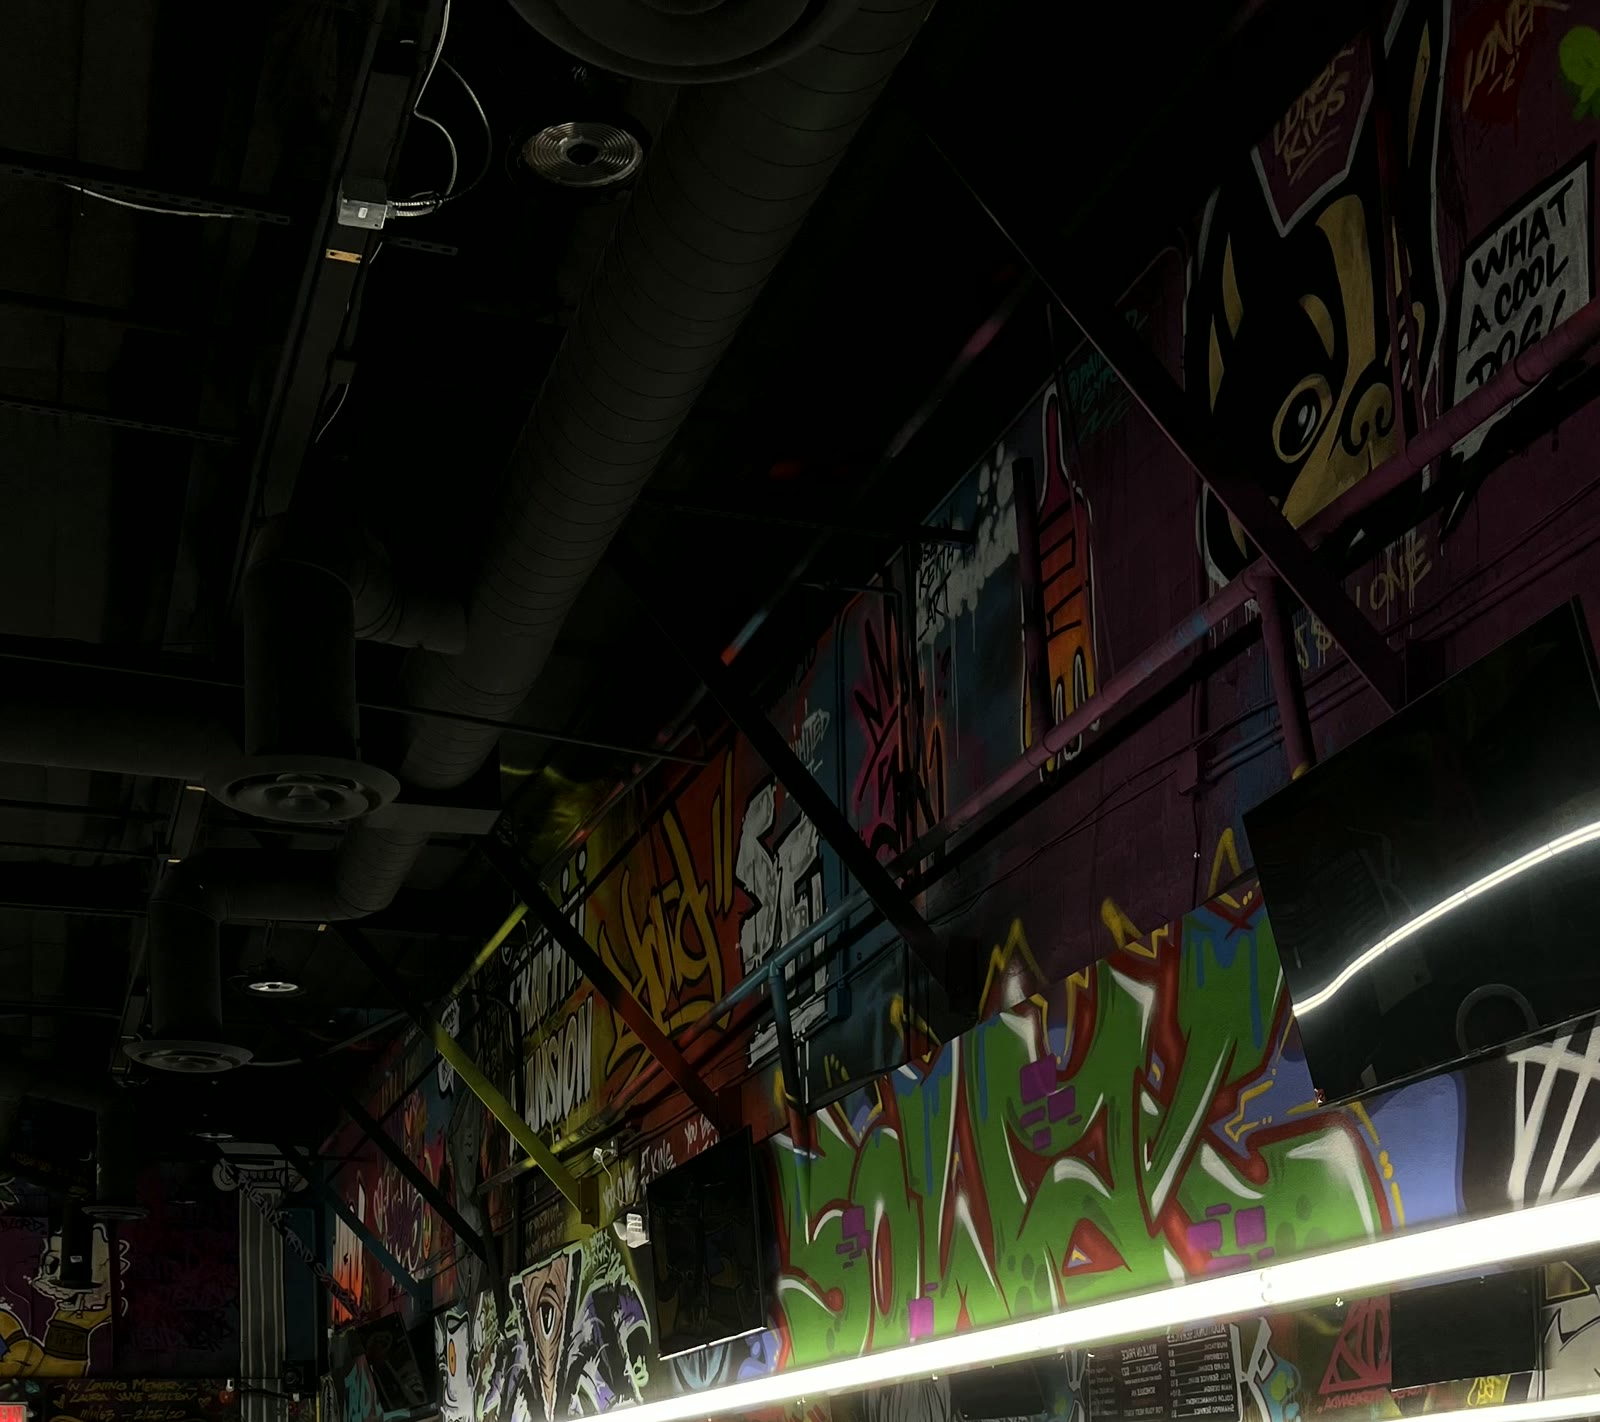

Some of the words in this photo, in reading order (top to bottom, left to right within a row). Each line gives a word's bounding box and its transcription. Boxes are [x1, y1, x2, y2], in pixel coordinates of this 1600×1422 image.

[1472, 179, 1574, 288] WHAT
[1467, 304, 1491, 350] A
[1494, 243, 1568, 324] COOL
